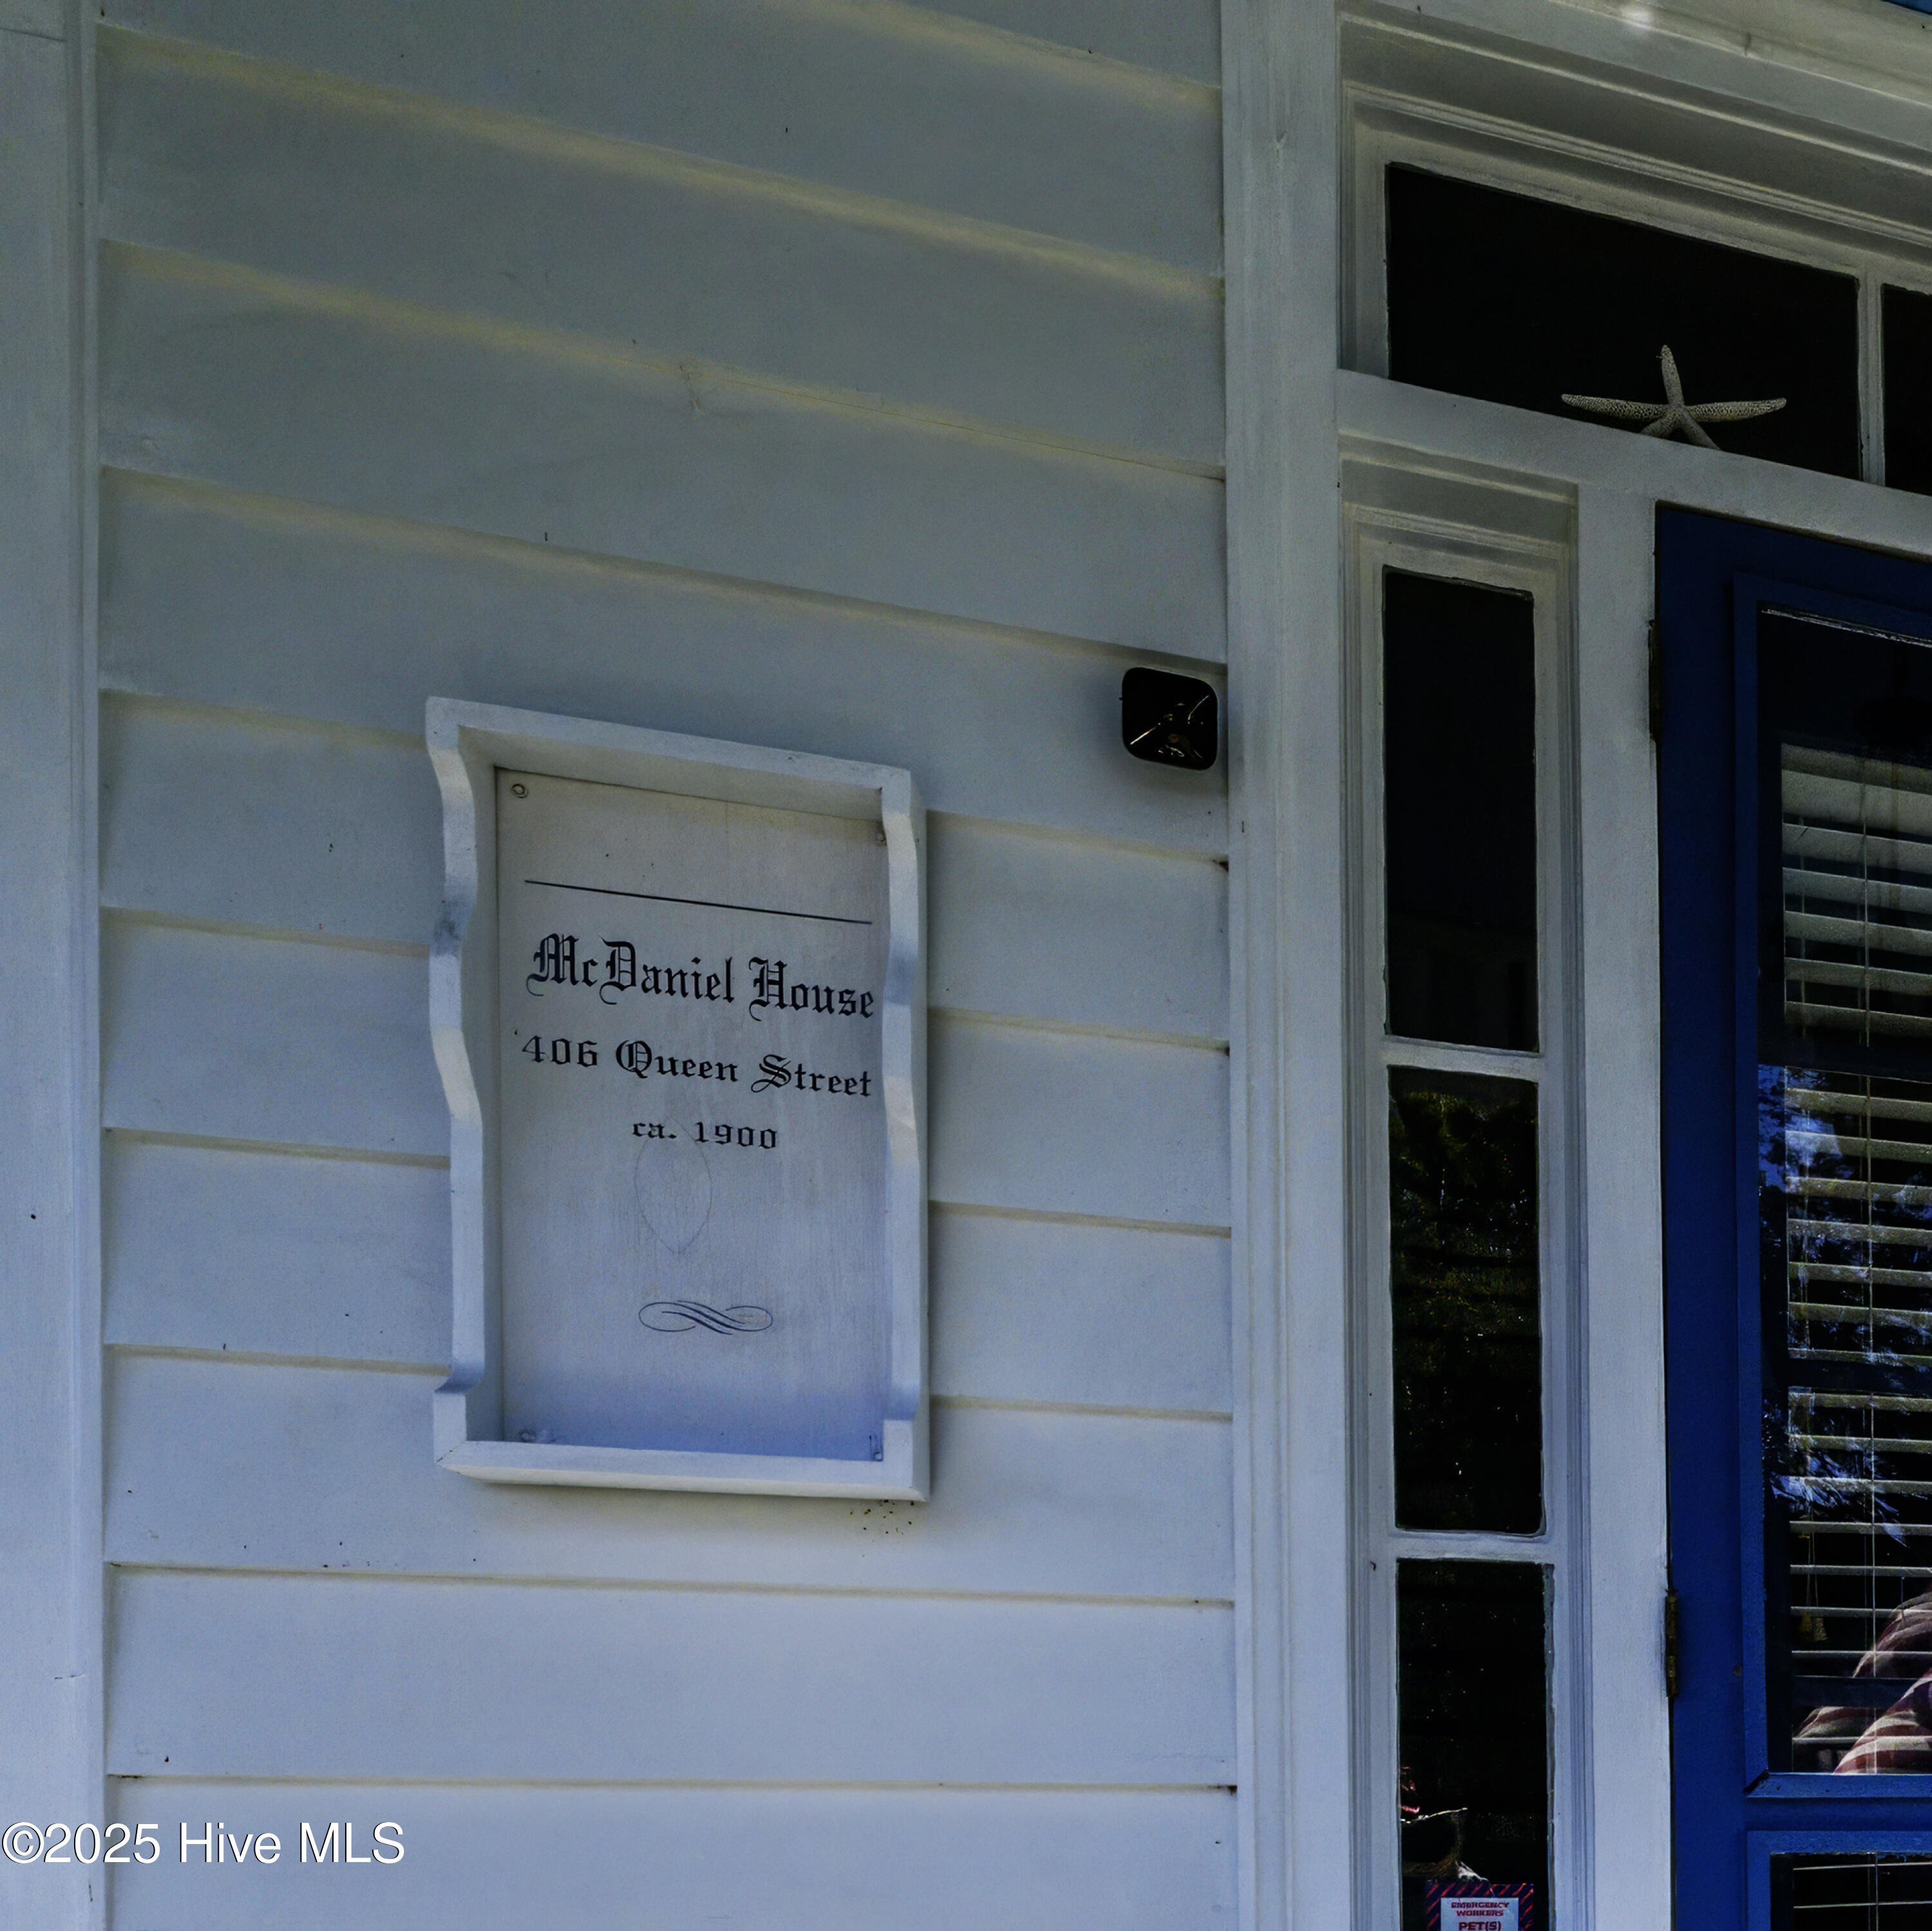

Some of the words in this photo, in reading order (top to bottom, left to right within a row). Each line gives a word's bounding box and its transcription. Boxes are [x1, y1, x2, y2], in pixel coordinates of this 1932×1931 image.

[526, 933, 736, 1005] McDaniel
[748, 956, 875, 1022] House
[522, 1034, 598, 1068] 406
[615, 1039, 738, 1083] Queen
[750, 1054, 872, 1097] Street
[632, 1121, 677, 1139] ca.
[695, 1121, 777, 1150] 1900
[1459, 1921, 1502, 1931] PET(S)
